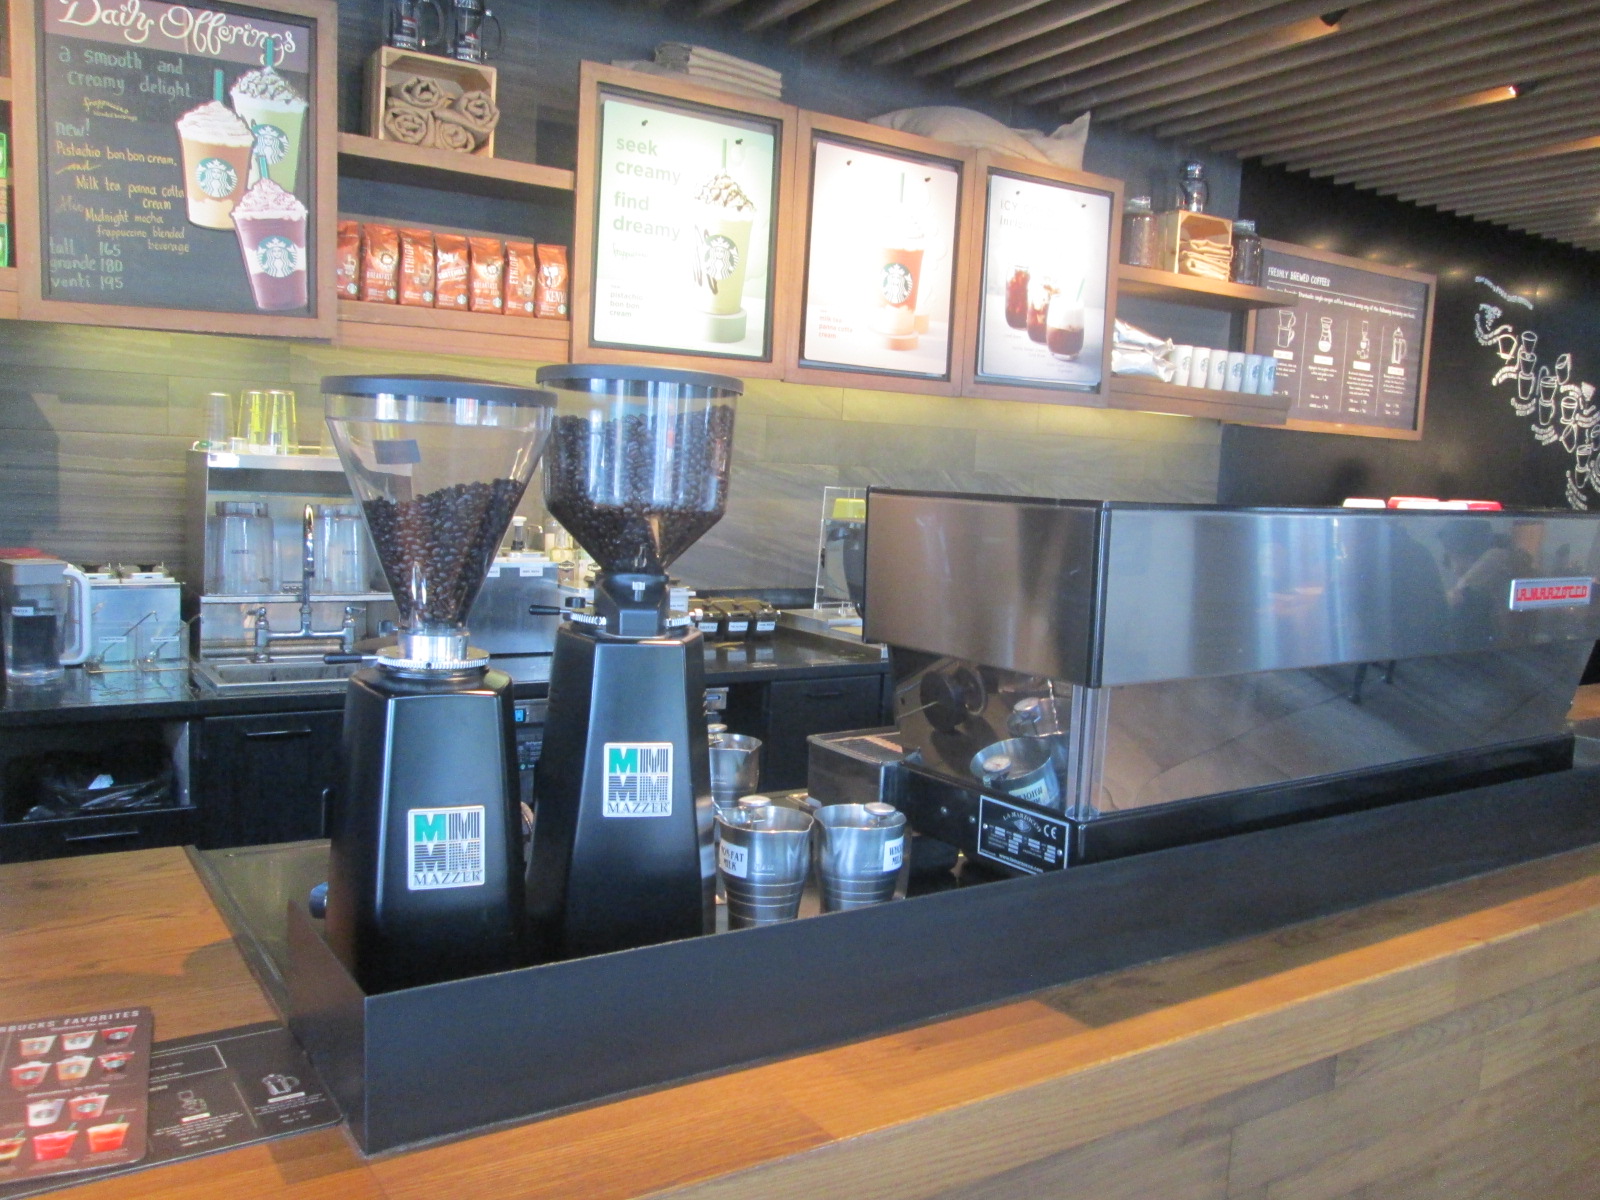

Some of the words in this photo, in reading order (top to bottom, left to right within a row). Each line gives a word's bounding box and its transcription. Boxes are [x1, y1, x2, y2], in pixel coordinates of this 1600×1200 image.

[58, 0, 154, 43] Daily
[160, 5, 296, 66] Offerings
[84, 48, 142, 70] smooth
[157, 59, 183, 75] and
[67, 69, 125, 96] creamy
[139, 76, 192, 101] delight
[107, 146, 125, 160] bon
[126, 148, 145, 162] bon
[616, 137, 658, 156] seek
[615, 161, 681, 185] creamy
[75, 174, 99, 190] Milk
[105, 177, 121, 191] tea
[128, 183, 157, 198] panna
[613, 191, 649, 211] find
[85, 207, 129, 227] Midnight
[134, 212, 164, 224] mocha
[152, 226, 185, 239] blended
[613, 216, 681, 241] dreamy
[49, 237, 74, 255] tall
[99, 242, 121, 257] 165
[147, 239, 190, 254] beverage
[50, 254, 96, 272] grande
[100, 259, 123, 273] 180
[50, 272, 91, 288] venti
[100, 276, 124, 290] 195
[607, 801, 670, 815] MAZZER
[414, 870, 480, 885] MAZZER
[63, 1010, 140, 1025] FAVORITES
